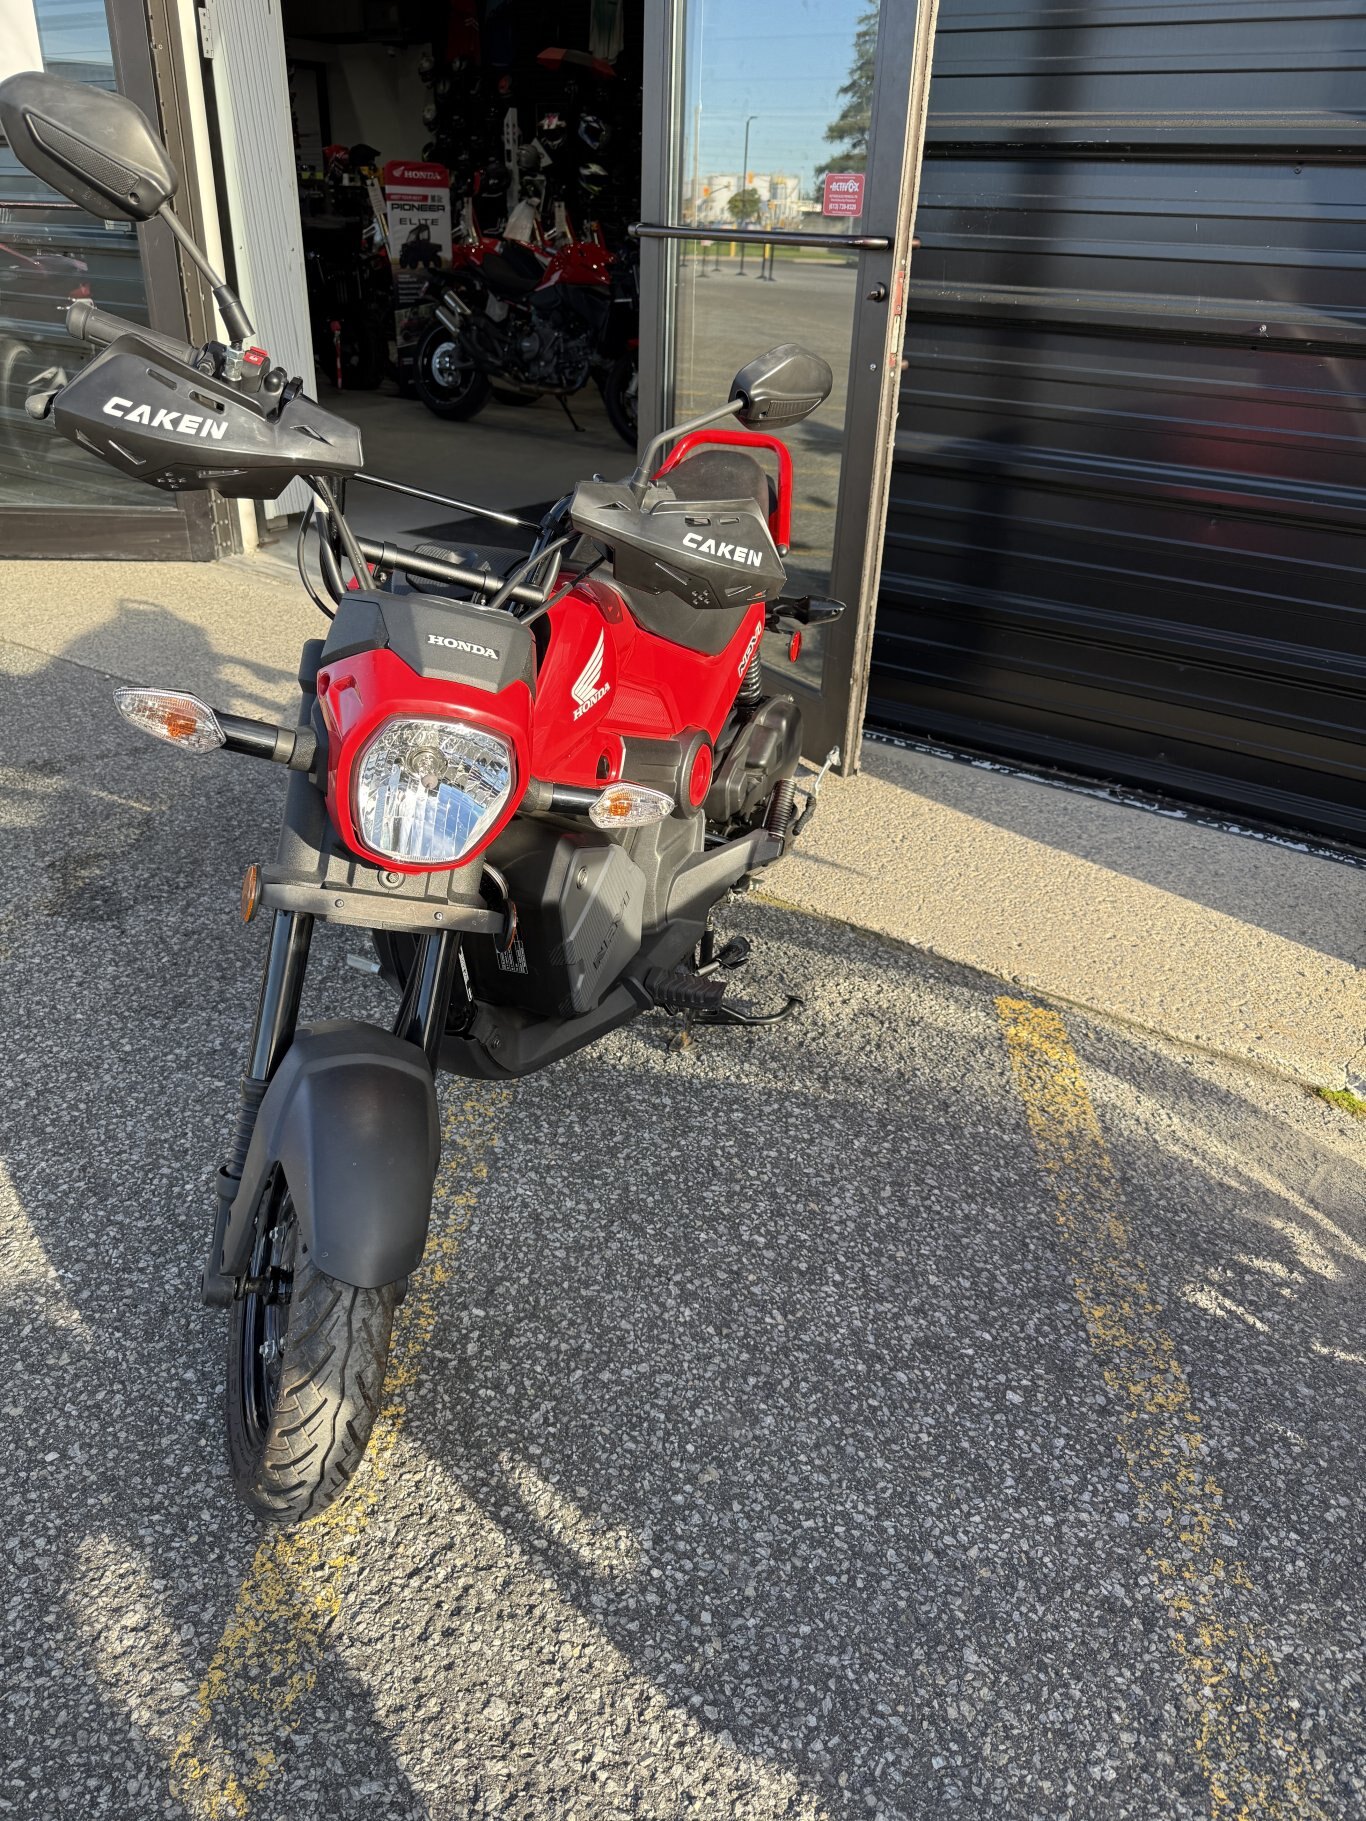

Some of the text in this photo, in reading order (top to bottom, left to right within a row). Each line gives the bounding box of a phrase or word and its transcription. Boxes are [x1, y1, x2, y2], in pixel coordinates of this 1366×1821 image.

[404, 170, 442, 179] HONDA
[391, 203, 446, 212] PIONEER
[399, 217, 440, 226] ELITE
[102, 396, 229, 440] CAKEN
[682, 532, 763, 567] CAKEN
[427, 634, 499, 660] HONDA
[737, 620, 762, 678] NAVI
[573, 681, 611, 721] HONDA
